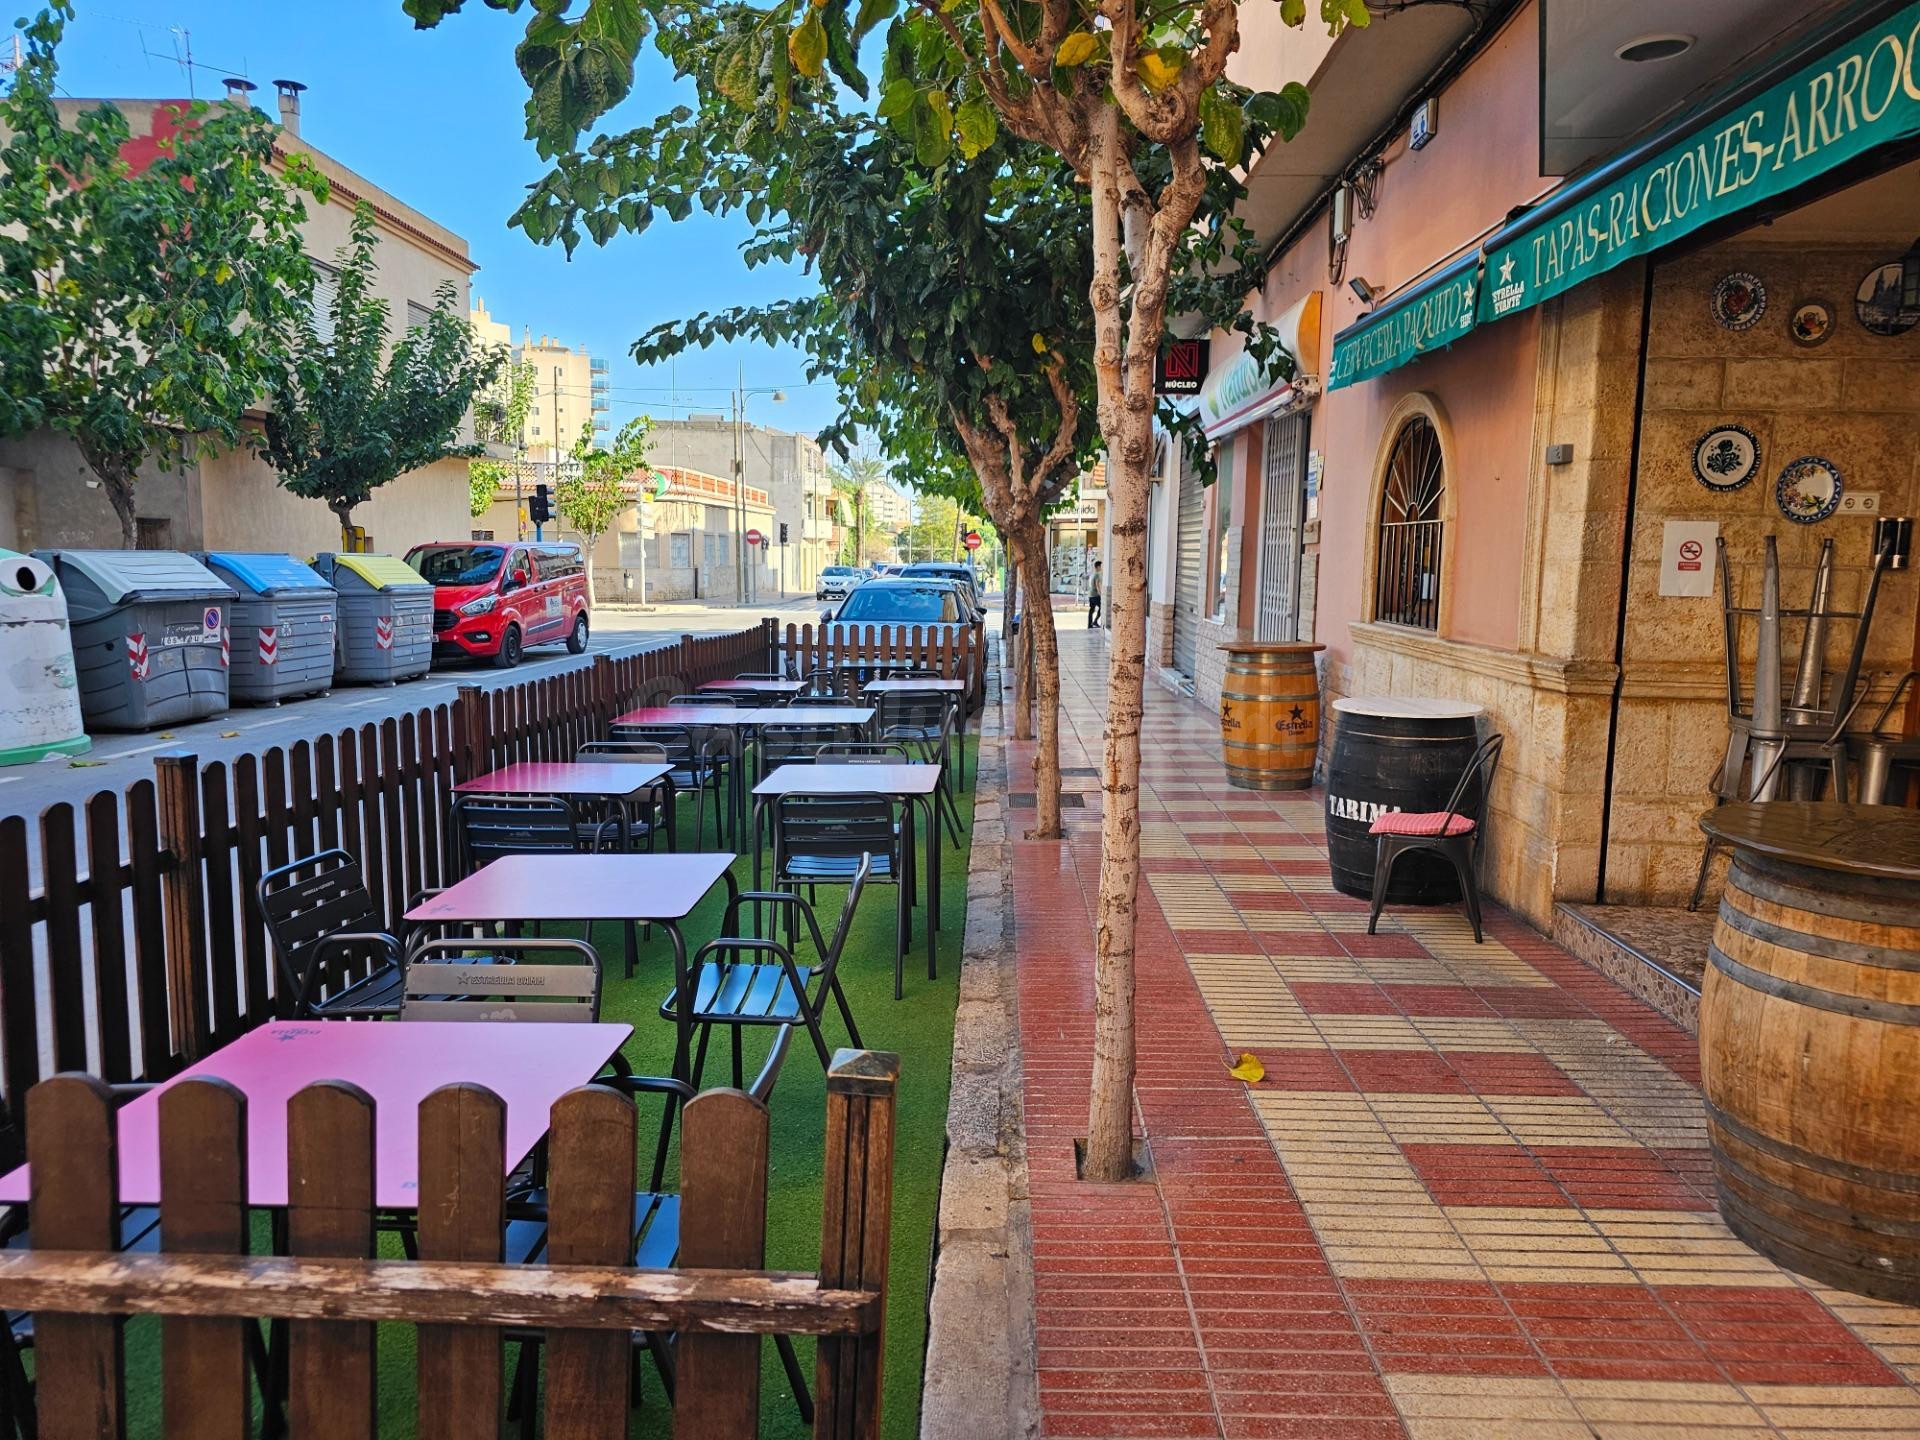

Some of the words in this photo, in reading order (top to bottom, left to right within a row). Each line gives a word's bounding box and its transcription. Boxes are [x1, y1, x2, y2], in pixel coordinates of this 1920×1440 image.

[1403, 282, 1462, 350] PAQUITO
[1165, 380, 1197, 389] NÚCLEO
[1275, 718, 1313, 732] Estrella
[1329, 794, 1401, 824] TARIM
[471, 975, 515, 986] ESTRELLA
[516, 975, 545, 986] DAMM
